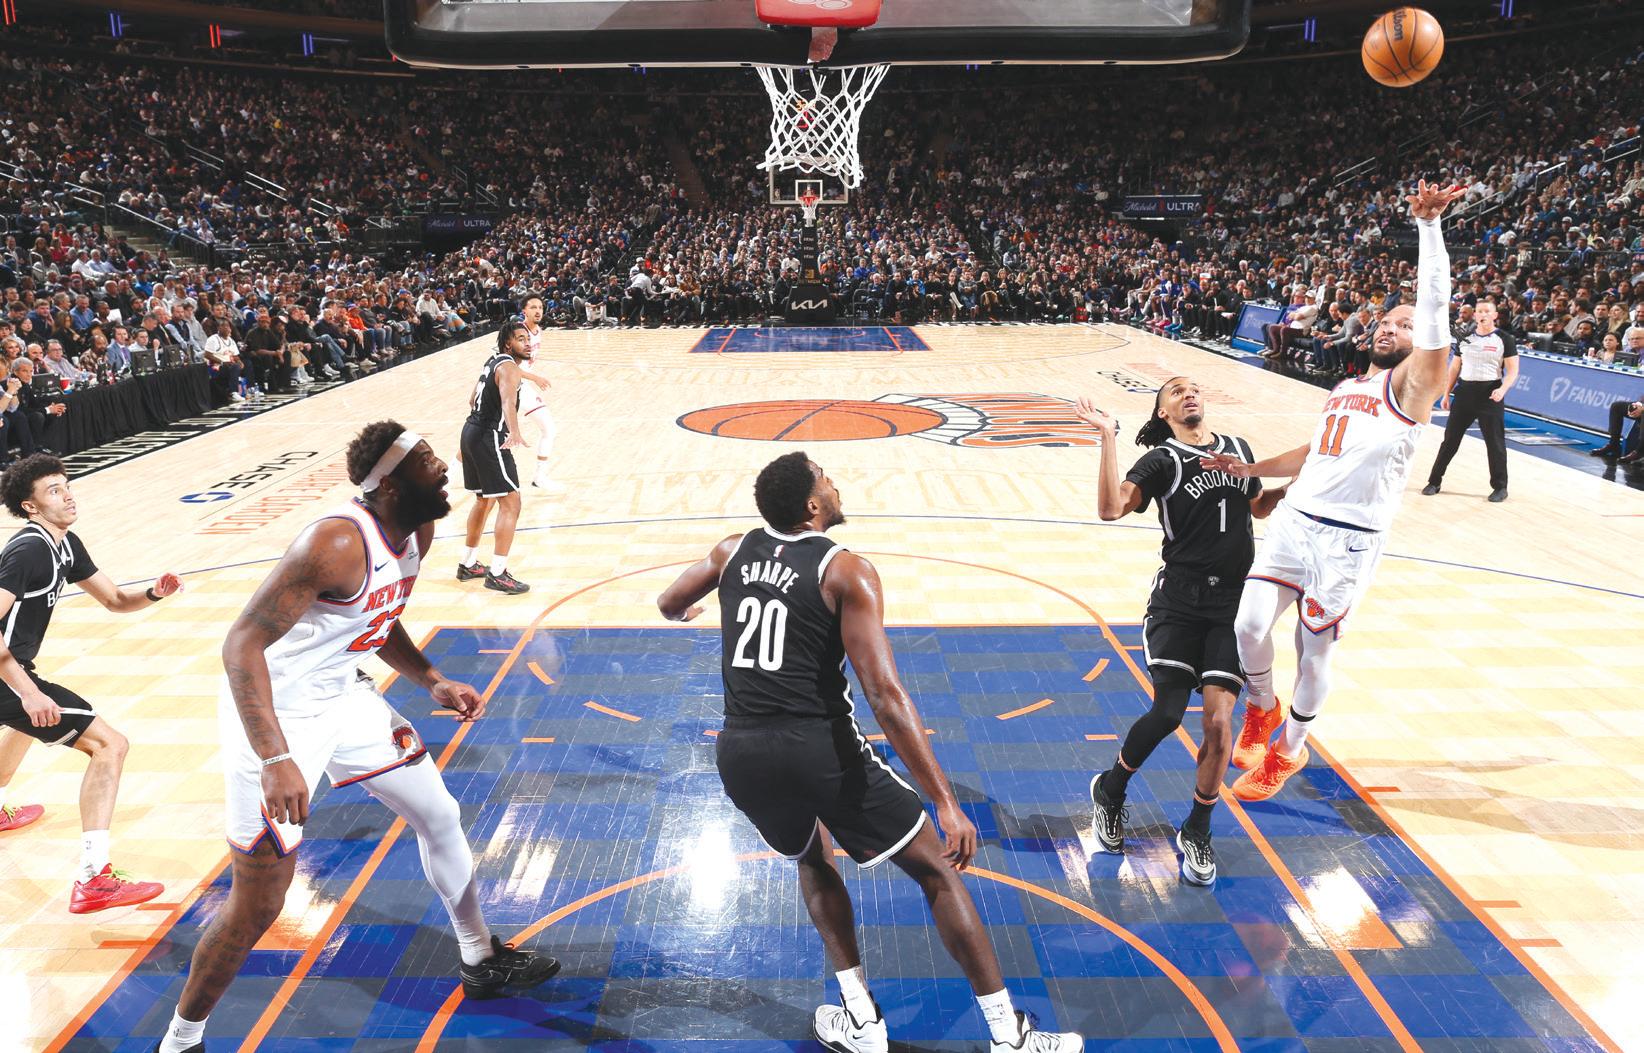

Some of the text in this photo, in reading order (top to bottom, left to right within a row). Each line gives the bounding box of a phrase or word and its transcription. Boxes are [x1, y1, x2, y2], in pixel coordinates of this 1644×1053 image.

[463, 220, 491, 228] ULTRA
[791, 299, 828, 310] KIA
[1342, 394, 1382, 418] YORK
[1568, 386, 1632, 410] FANDU
[1318, 414, 1350, 457] 11
[208, 451, 319, 489] CHASE
[1184, 470, 1250, 500] BROOKLYN
[193, 495, 323, 535] GARDEN
[1218, 498, 1226, 533] 1
[740, 560, 800, 594] SHARPE
[361, 581, 398, 613] NEW
[731, 596, 788, 672] 20
